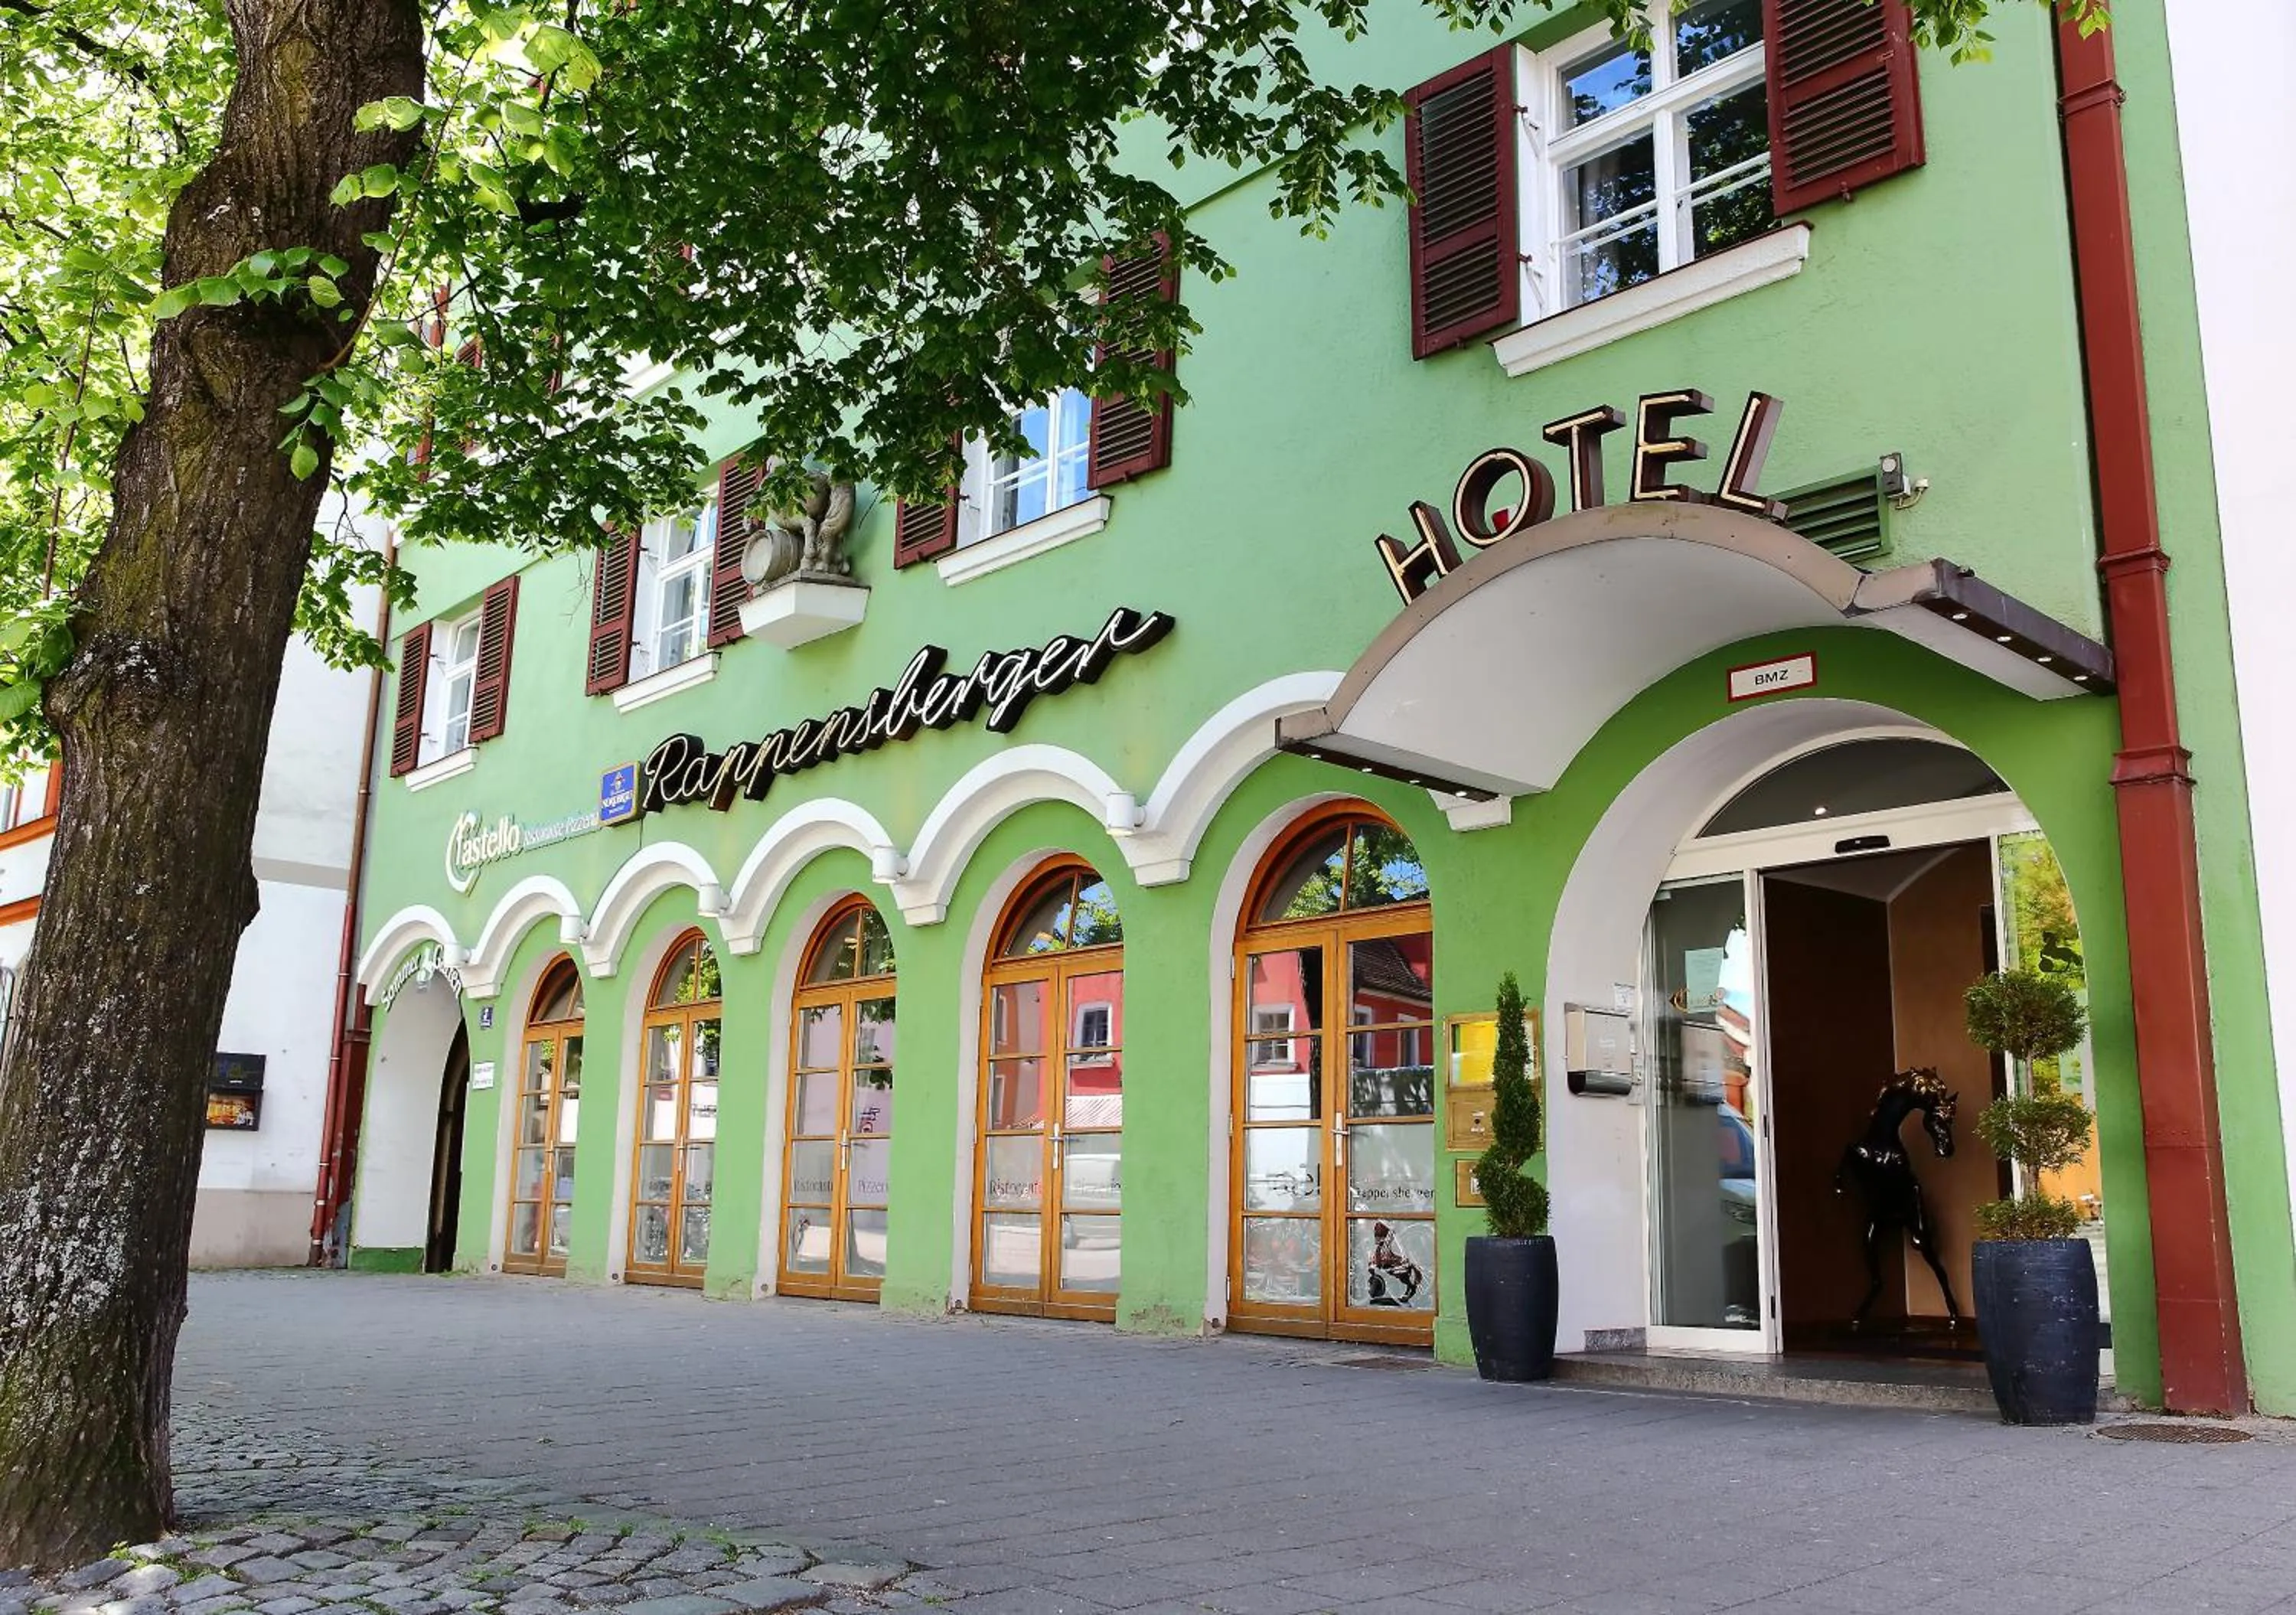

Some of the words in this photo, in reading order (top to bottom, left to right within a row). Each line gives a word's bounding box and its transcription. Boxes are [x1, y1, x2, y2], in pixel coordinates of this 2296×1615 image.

[1375, 389, 1788, 605] HOTEL
[641, 607, 1176, 811] Rappensberger
[1755, 670, 1789, 686] BMZ
[445, 810, 521, 893] Castello
[380, 952, 420, 1013] Sommer
